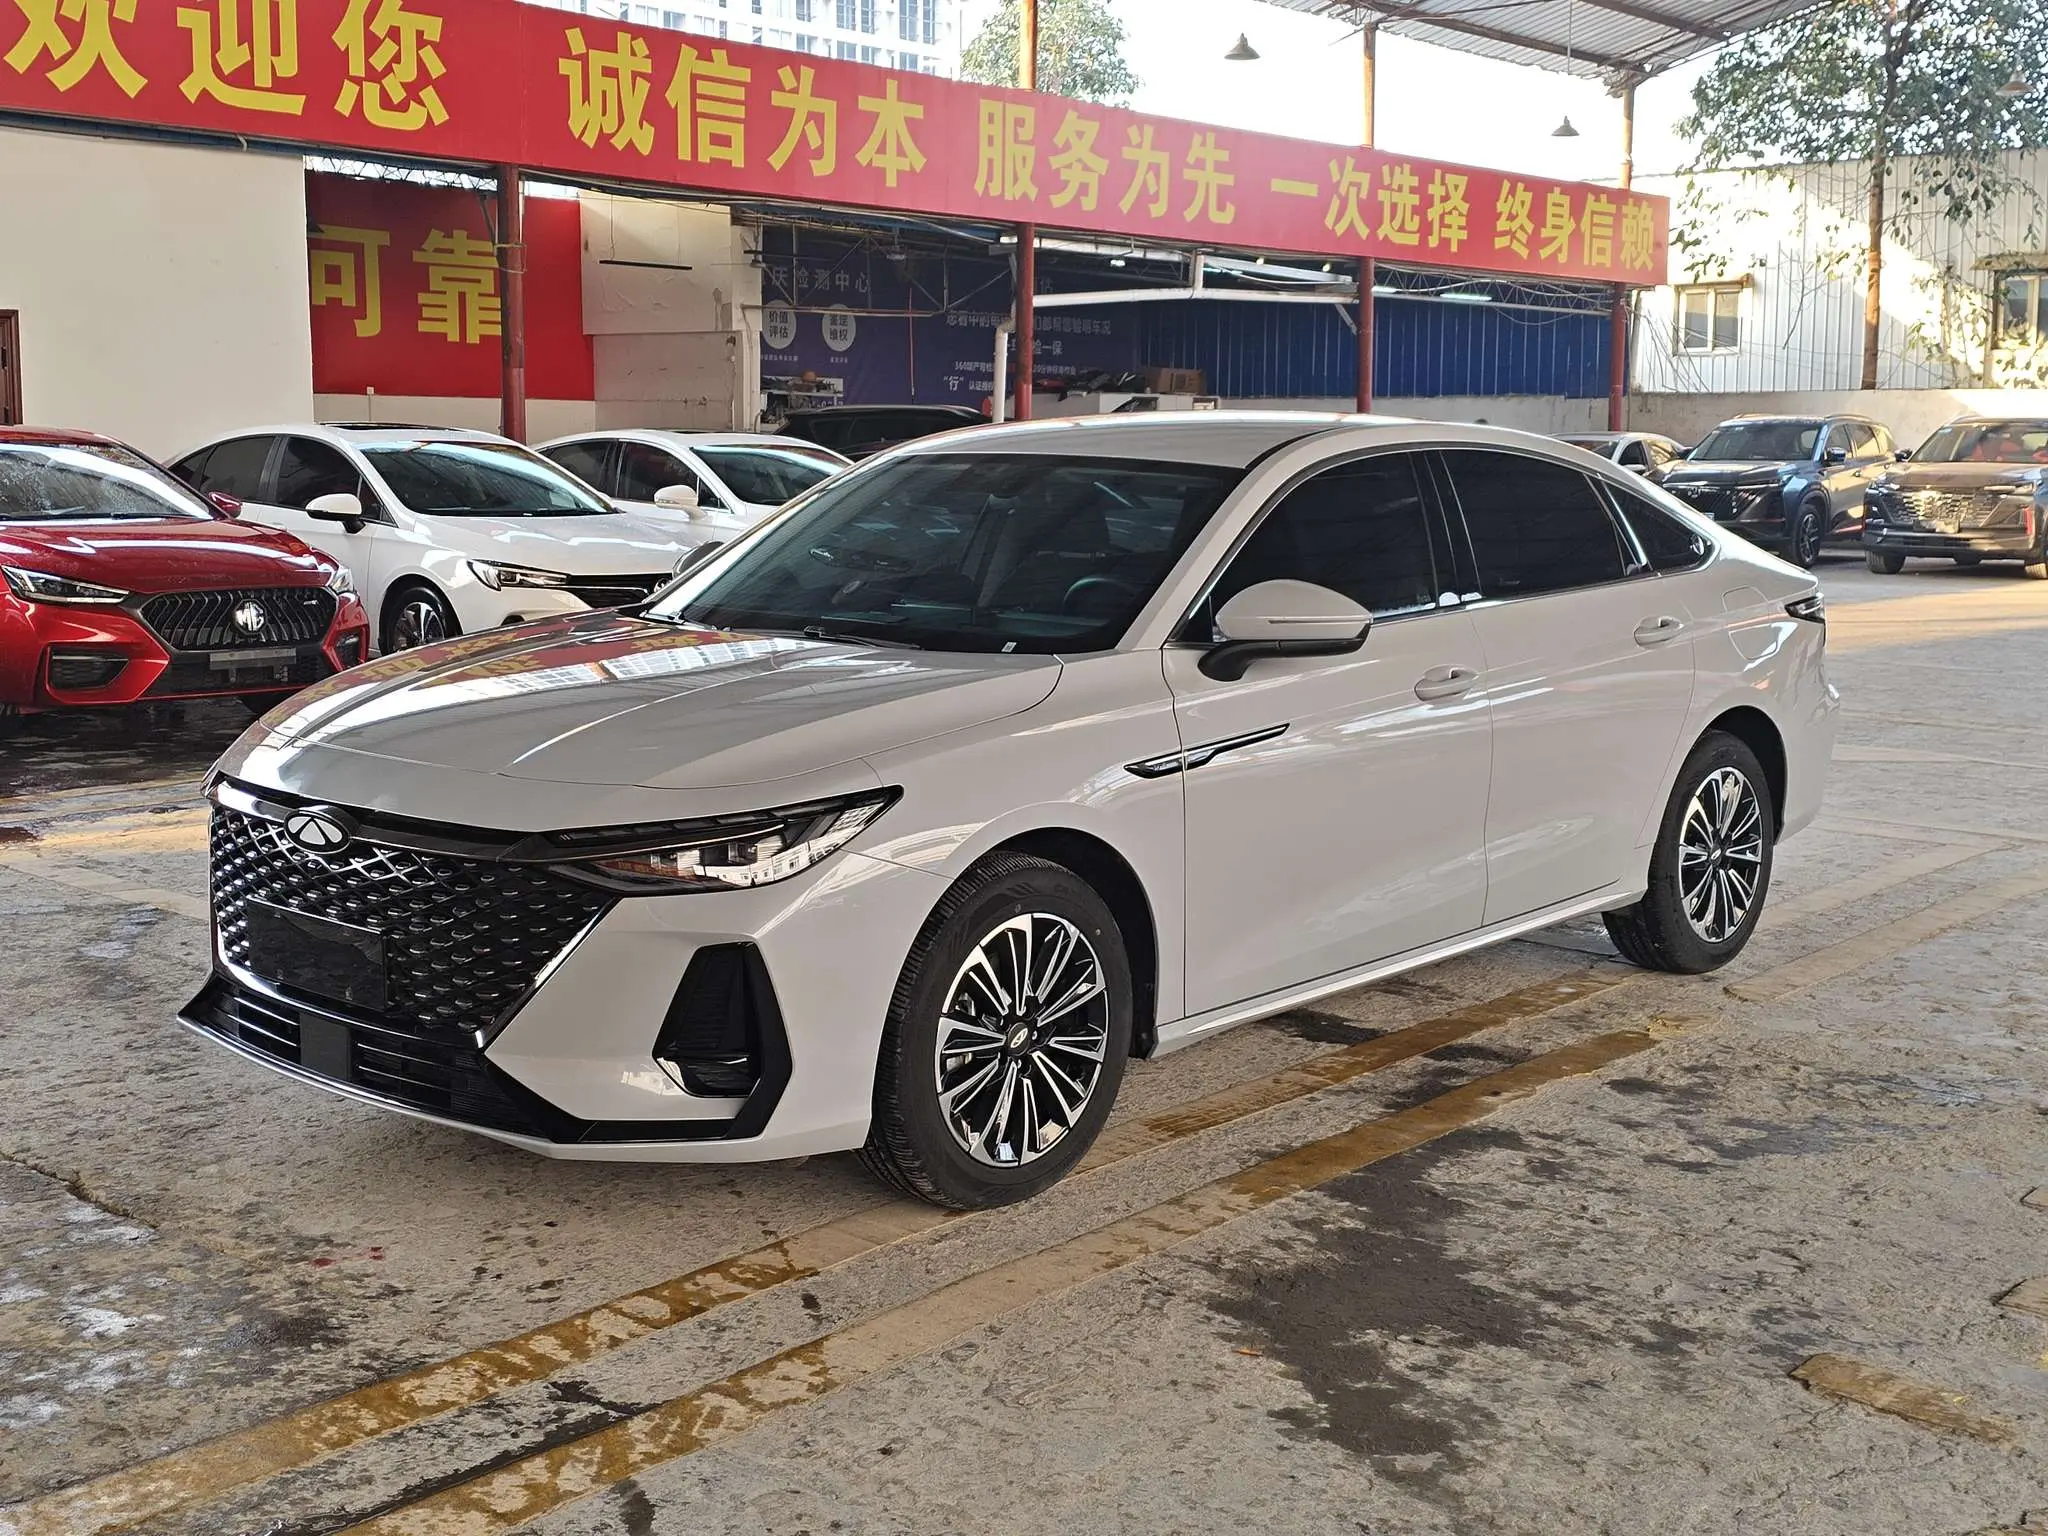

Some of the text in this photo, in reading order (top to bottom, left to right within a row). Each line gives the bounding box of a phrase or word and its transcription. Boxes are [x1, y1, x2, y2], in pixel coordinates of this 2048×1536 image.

[4, 0, 1655, 271] 欢迎您 诚信为本 服务为先 一次选择 终身信赖
[309, 224, 501, 344] 可靠
[761, 265, 871, 293] 庆检测中心
[235, 601, 265, 632] MG
